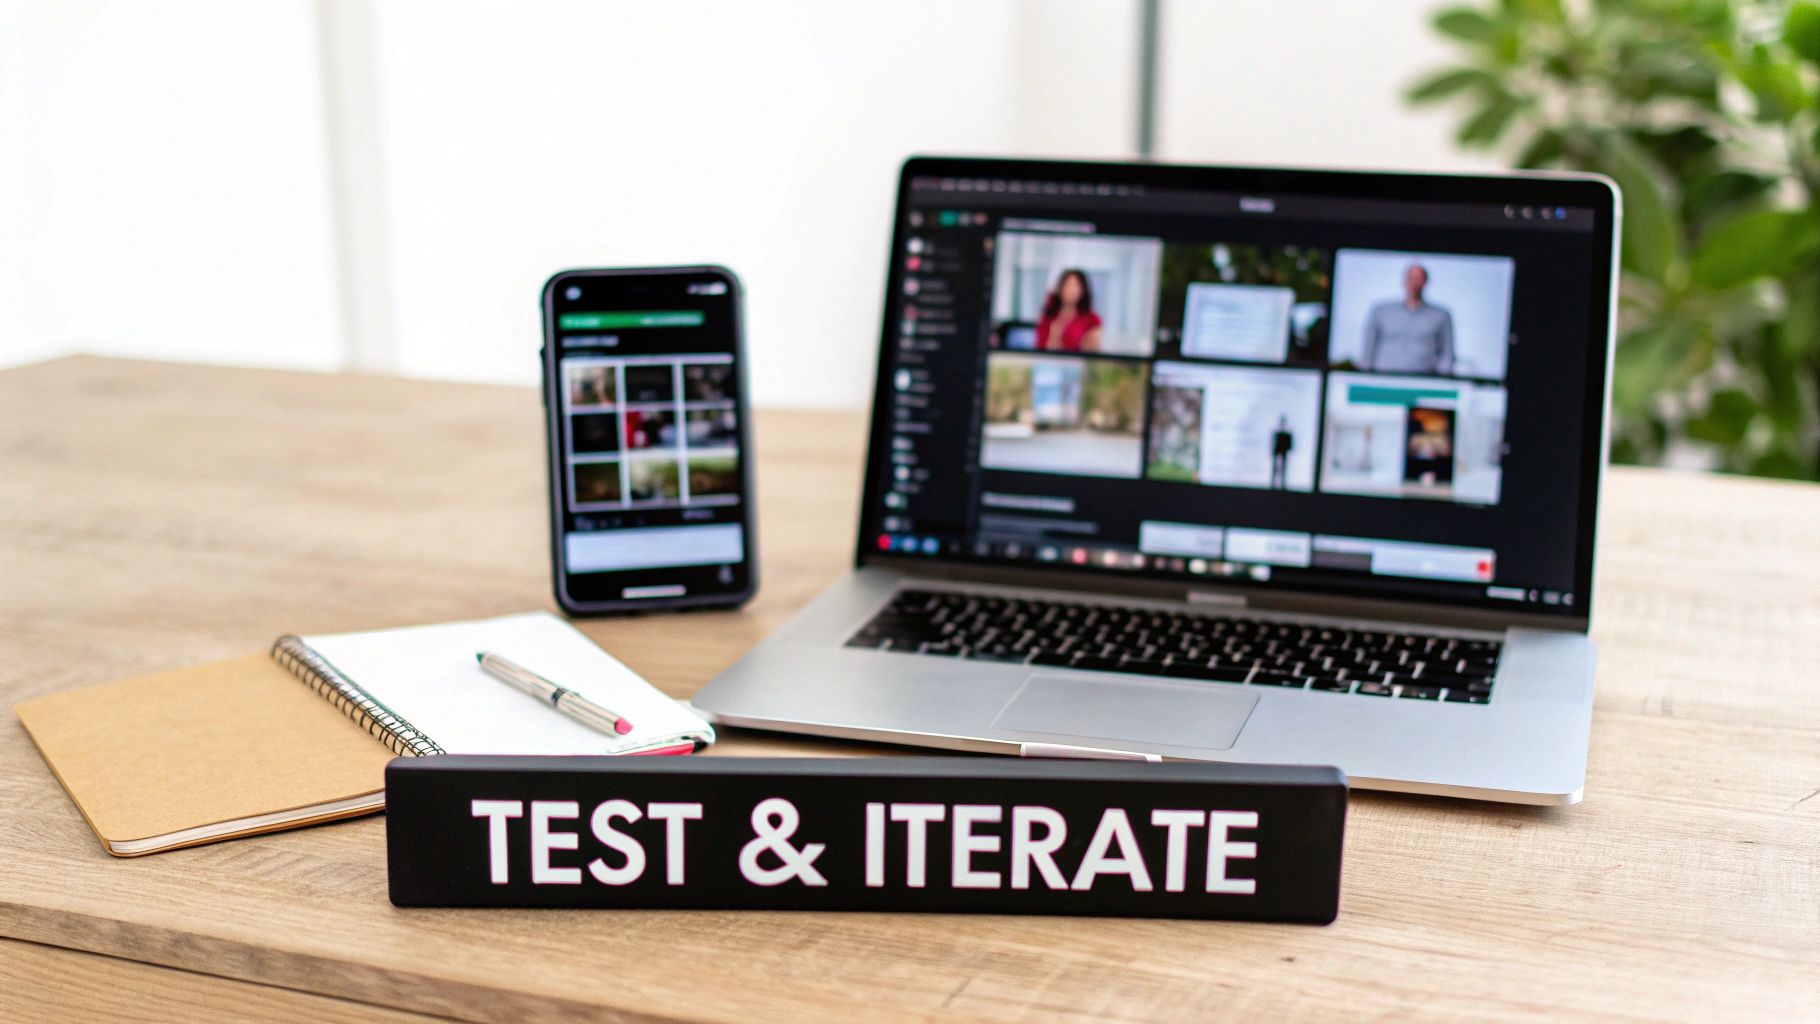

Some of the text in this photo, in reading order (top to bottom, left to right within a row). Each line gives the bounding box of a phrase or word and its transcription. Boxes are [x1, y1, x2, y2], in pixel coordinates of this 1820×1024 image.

[471, 798, 1259, 894] TEST & ITERATE
